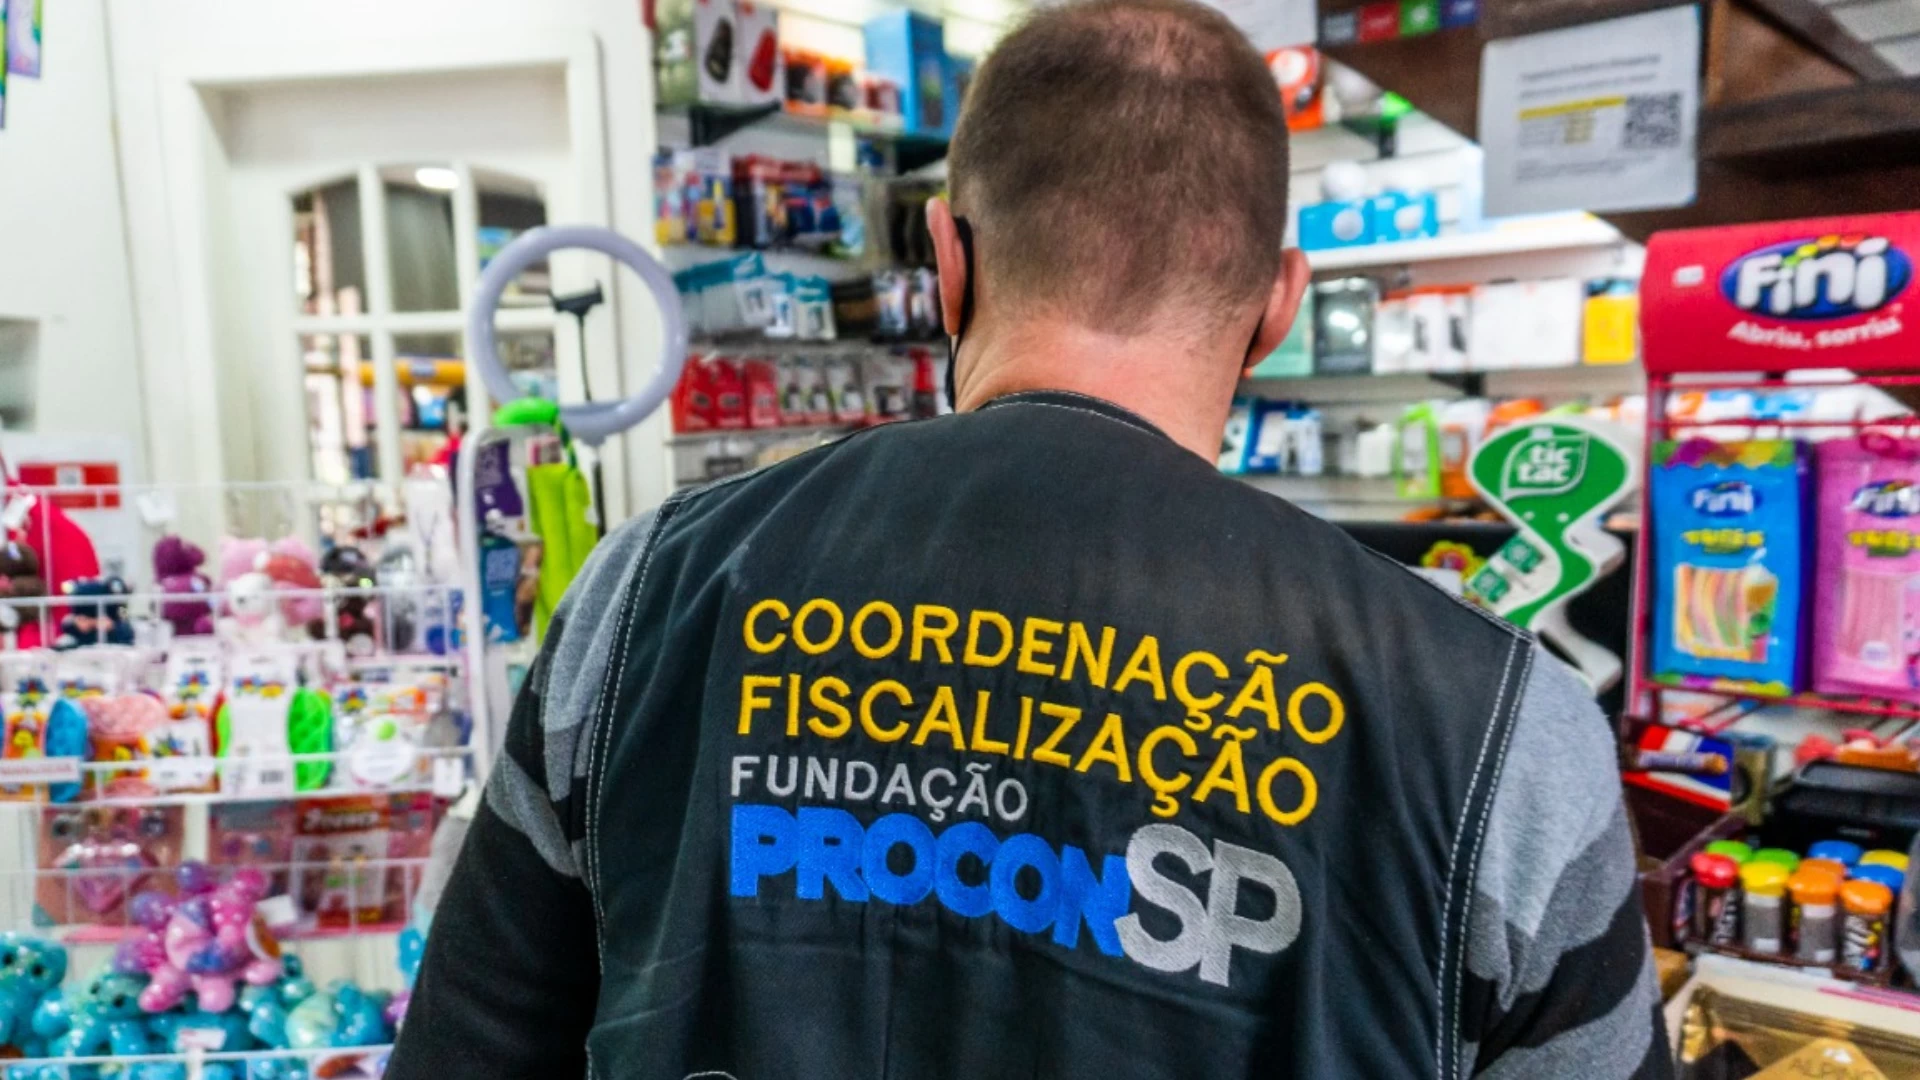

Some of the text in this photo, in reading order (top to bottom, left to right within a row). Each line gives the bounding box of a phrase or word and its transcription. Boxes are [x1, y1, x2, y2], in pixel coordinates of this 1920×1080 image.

[1736, 236, 1889, 315] Fini
[1517, 462, 1571, 484] tac
[1530, 440, 1573, 465] tic
[742, 598, 1345, 744] COORDENAÇÃO
[737, 672, 1319, 827] FISCALIZAÇÃO
[730, 754, 1029, 823] FUNDAÇÃO
